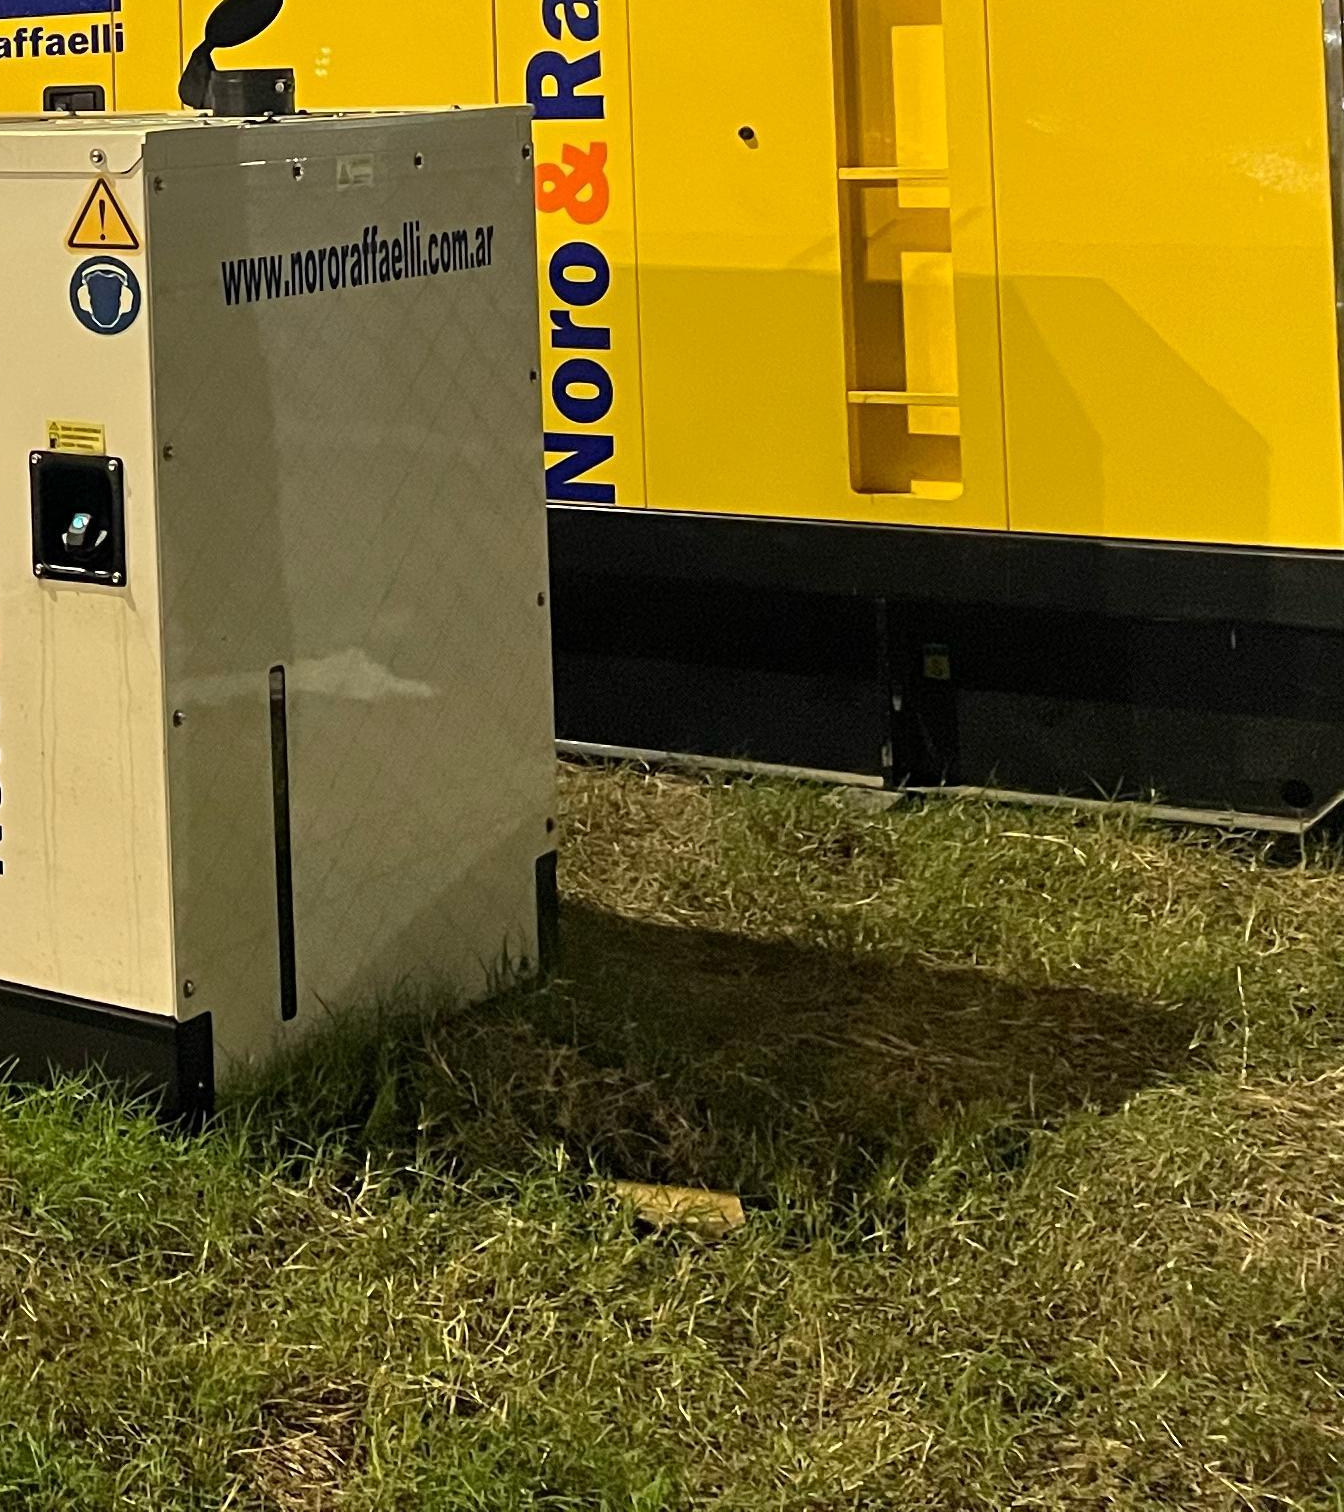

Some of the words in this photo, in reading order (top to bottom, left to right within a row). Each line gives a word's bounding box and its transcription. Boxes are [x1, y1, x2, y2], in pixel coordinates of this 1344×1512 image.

[535, 141, 610, 225] &
[221, 220, 494, 306] www.nororaffaelli.com.ar
[545, 241, 616, 504] Noro
